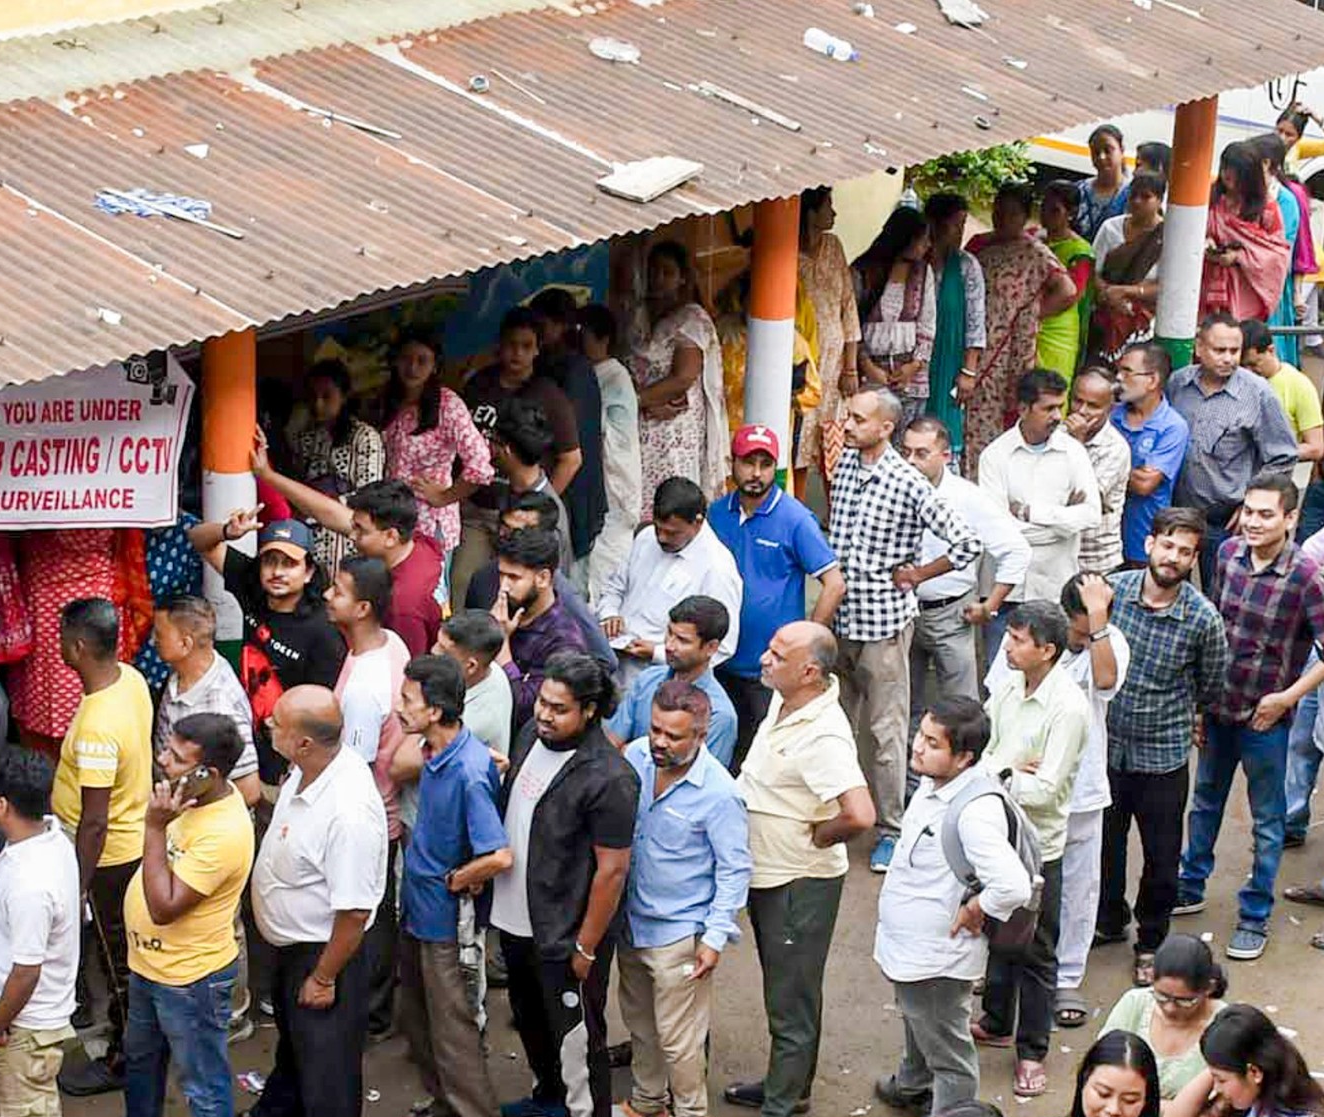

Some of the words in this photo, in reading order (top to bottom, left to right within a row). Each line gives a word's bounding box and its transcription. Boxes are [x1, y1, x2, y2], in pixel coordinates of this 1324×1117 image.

[3, 401, 36, 424] YOU
[41, 400, 74, 423] ARE
[80, 399, 142, 421] UNDER
[9, 436, 100, 477] CASTING
[119, 436, 173, 475] CCTV
